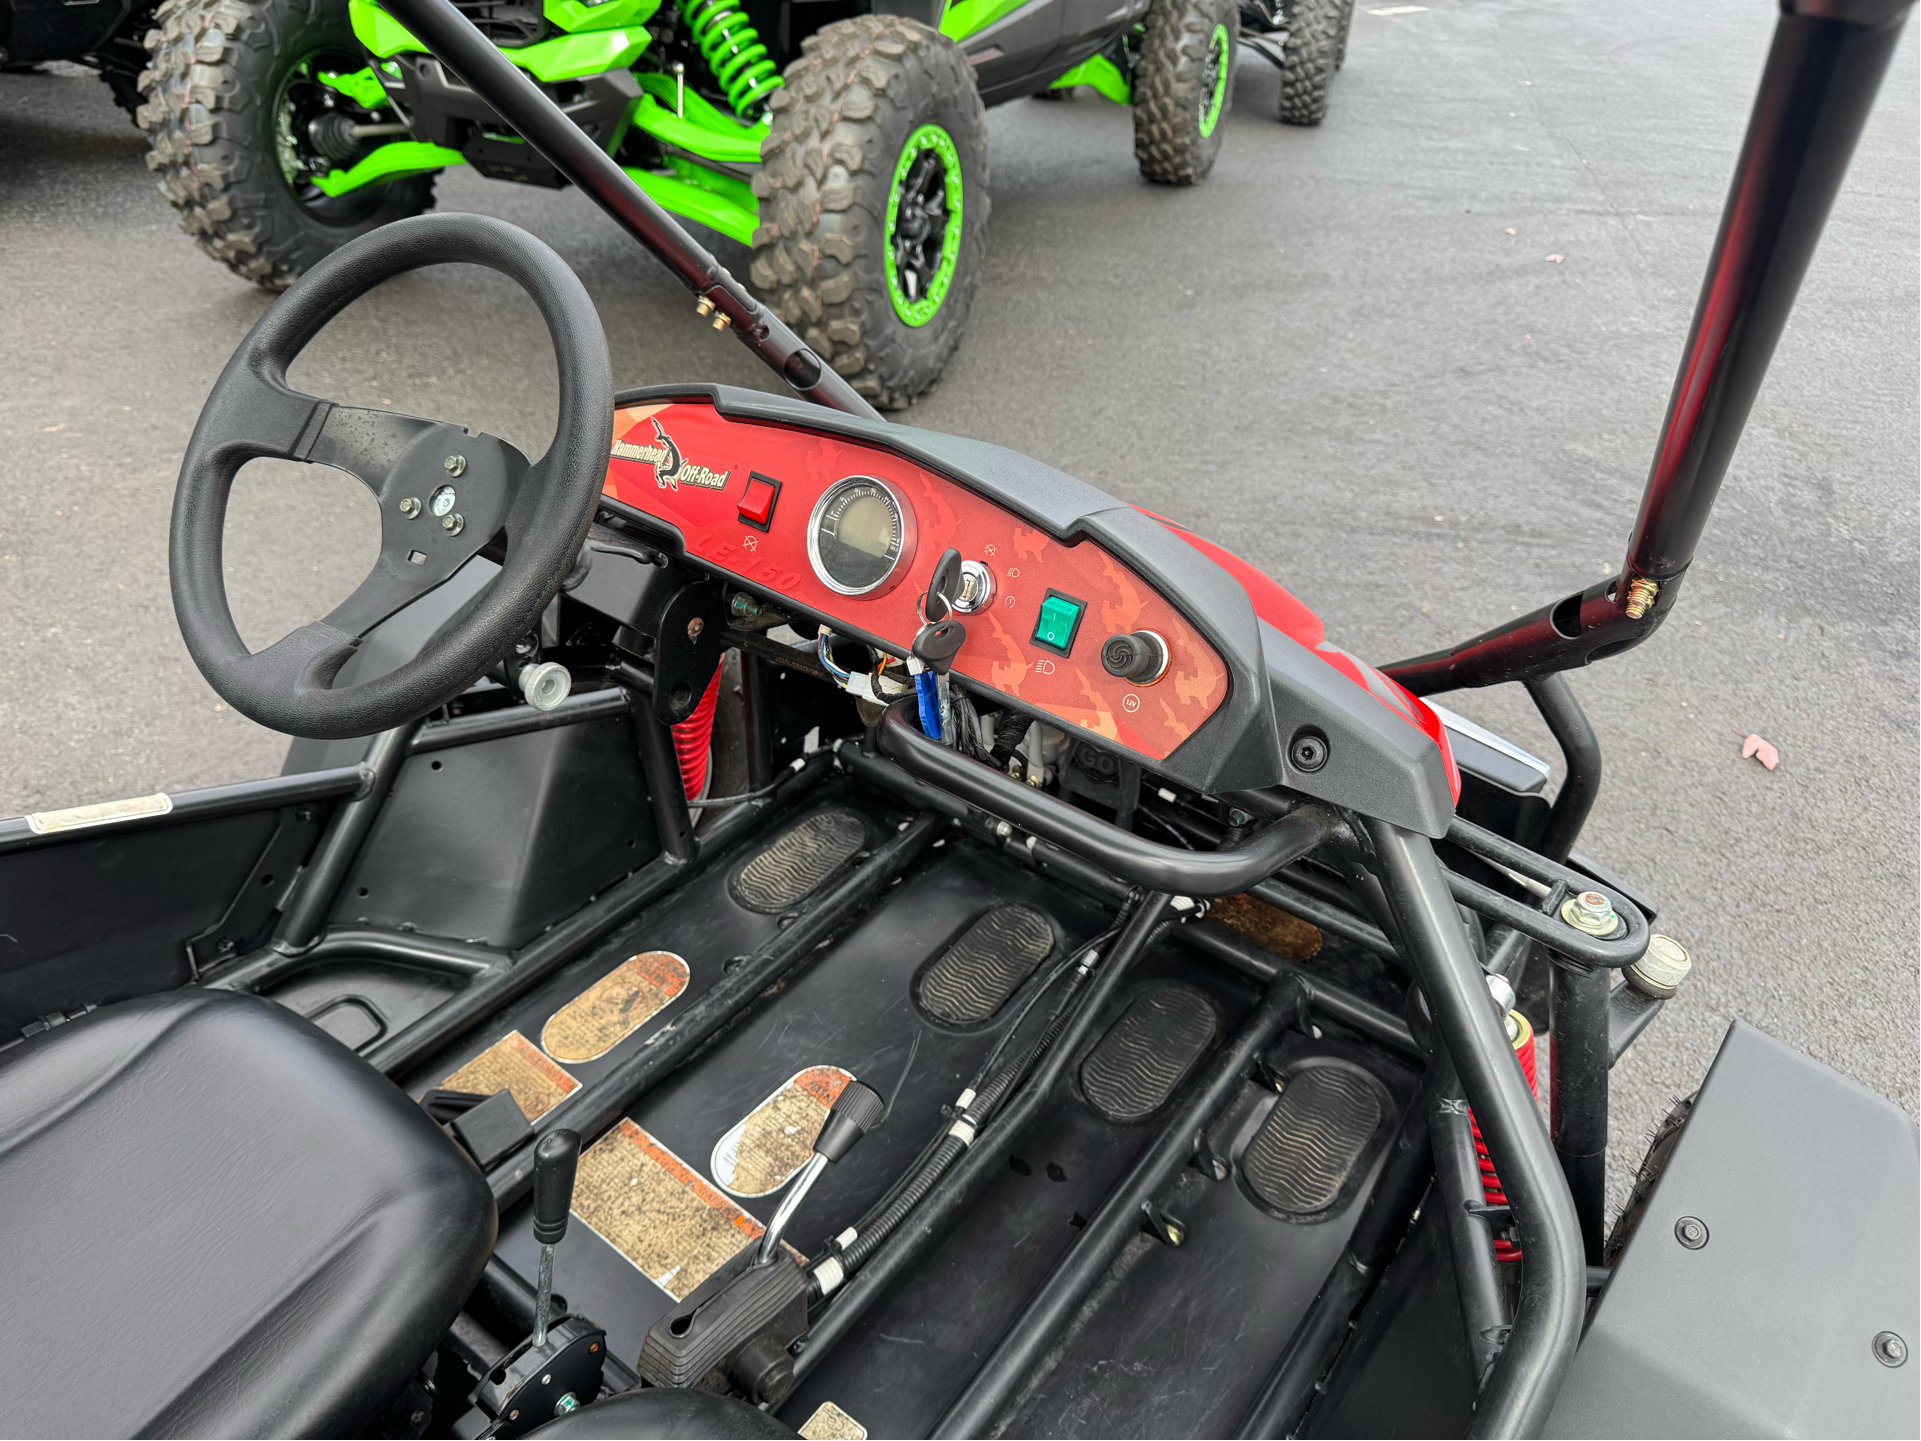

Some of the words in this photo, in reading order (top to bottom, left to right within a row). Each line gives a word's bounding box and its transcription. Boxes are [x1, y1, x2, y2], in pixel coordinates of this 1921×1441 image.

[610, 438, 670, 466] Hammerhead
[680, 463, 731, 491] Off-Road
[689, 532, 801, 590] LE-150
[1126, 698, 1137, 708] 12V
